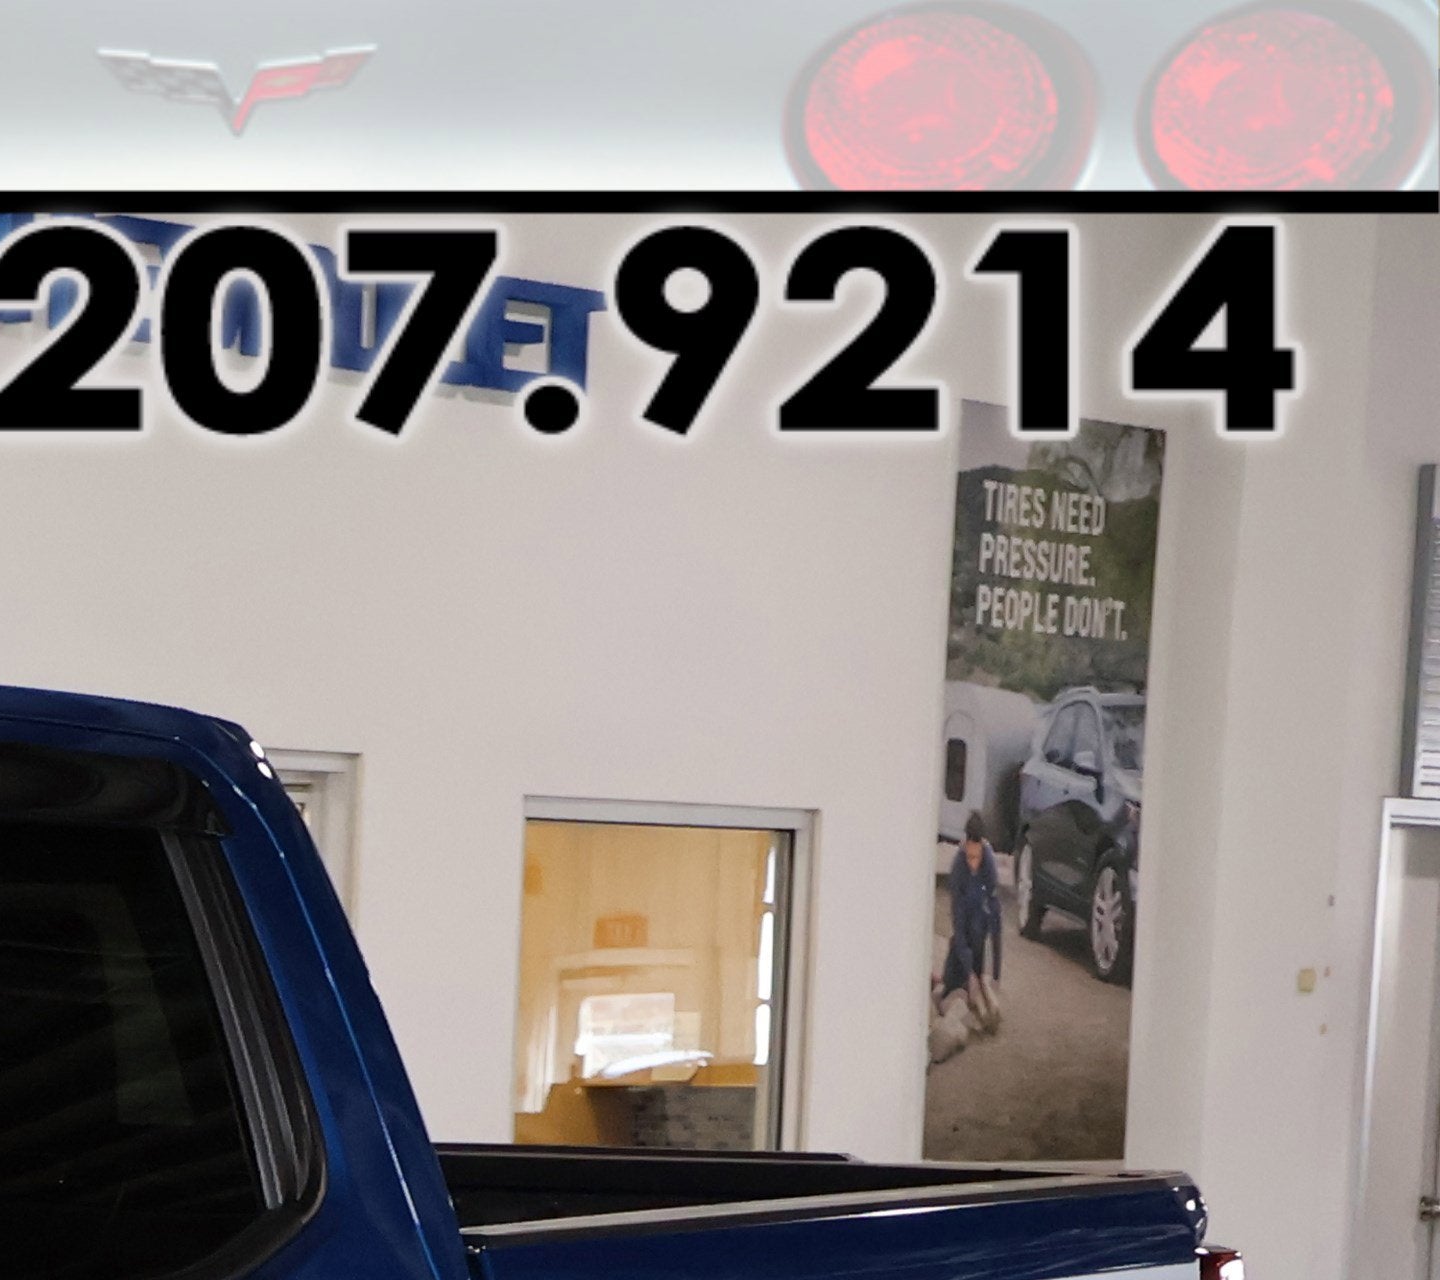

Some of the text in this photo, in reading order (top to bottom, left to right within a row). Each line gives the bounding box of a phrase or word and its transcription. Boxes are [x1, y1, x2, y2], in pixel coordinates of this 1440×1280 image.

[983, 479, 1107, 536] TIRES NEED
[979, 532, 1096, 587] PRESSURE.
[976, 584, 1129, 641] PEOPLE DON'T.
